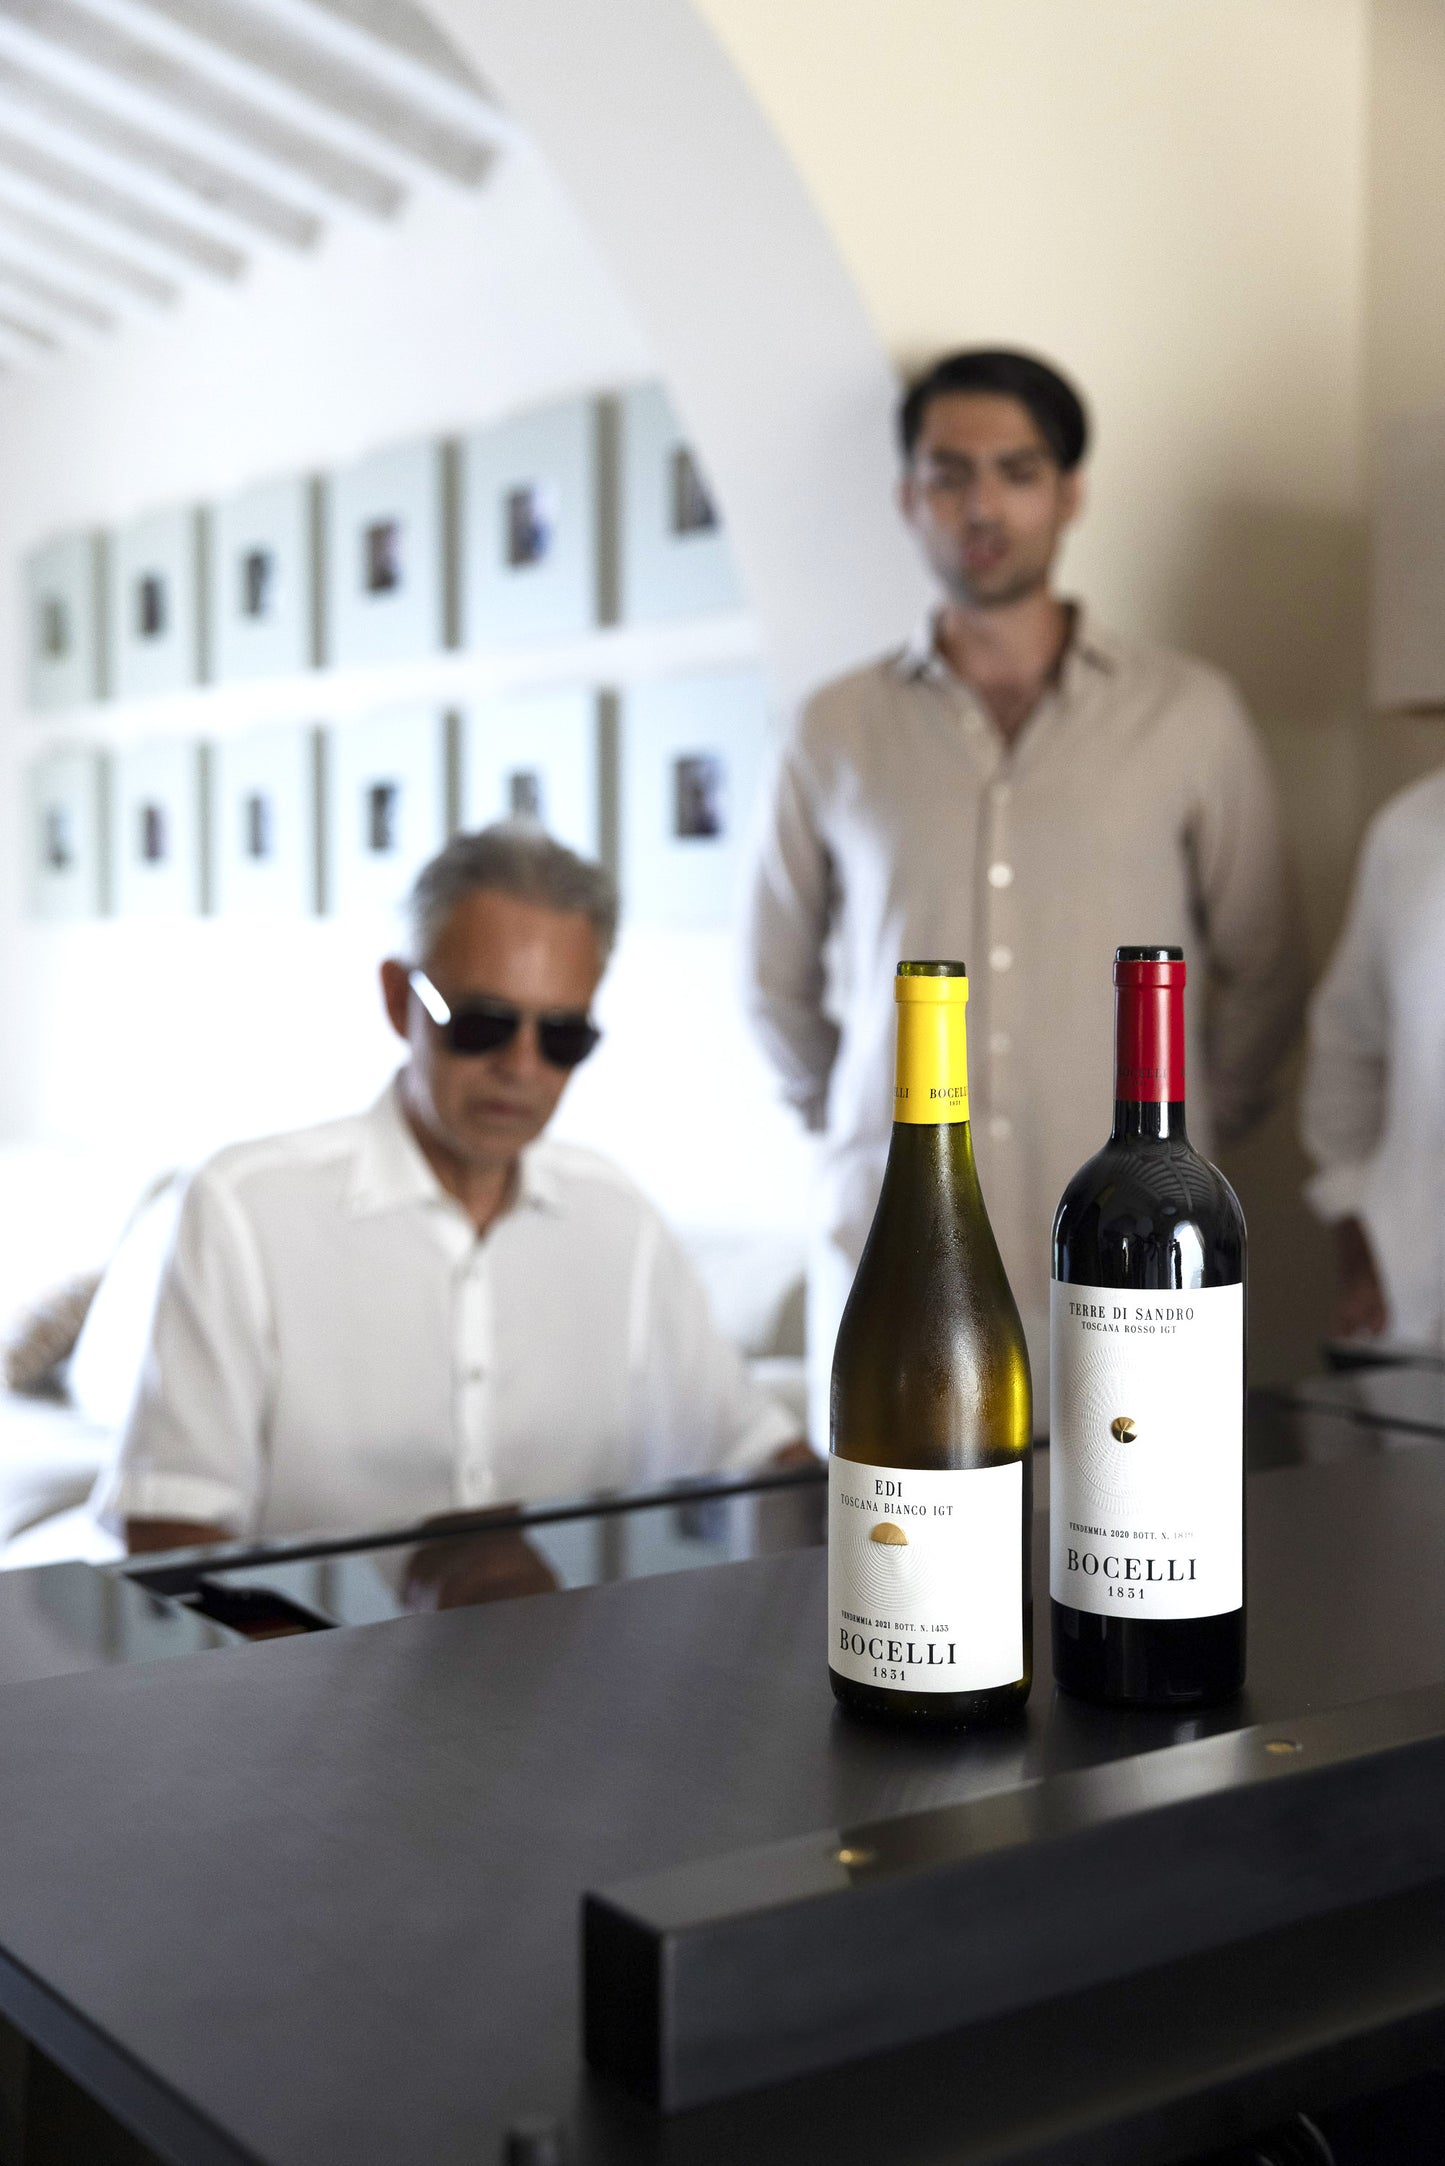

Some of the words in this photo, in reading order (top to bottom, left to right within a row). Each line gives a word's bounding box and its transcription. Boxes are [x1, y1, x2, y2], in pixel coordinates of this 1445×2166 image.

[1069, 1302, 1106, 1319] TERRE
[1112, 1307, 1127, 1320] DI
[1135, 1307, 1194, 1321] SANDRO
[1081, 1321, 1120, 1333] TOSCANA
[1124, 1325, 1156, 1334] ROSSO
[1160, 1326, 1177, 1334] IGT
[875, 1479, 903, 1498] EDI
[840, 1493, 879, 1512] TOSCANA
[884, 1502, 927, 1516] BIANCO
[933, 1505, 954, 1516] IGT
[1069, 1521, 1107, 1537] VENDEMMIA
[1110, 1529, 1130, 1539] 2020
[1133, 1531, 1157, 1540] BOTT.
[1161, 1531, 1170, 1540] N.
[1067, 1548, 1197, 1582] BOCELLI
[1107, 1586, 1145, 1600] 1831
[841, 1609, 872, 1626] VENDEMMIA
[875, 1619, 891, 1629] 2021
[894, 1622, 917, 1632] BOTT.
[920, 1624, 928, 1632] N.
[840, 1627, 957, 1665] BOCELLI
[872, 1666, 906, 1681] 1831
